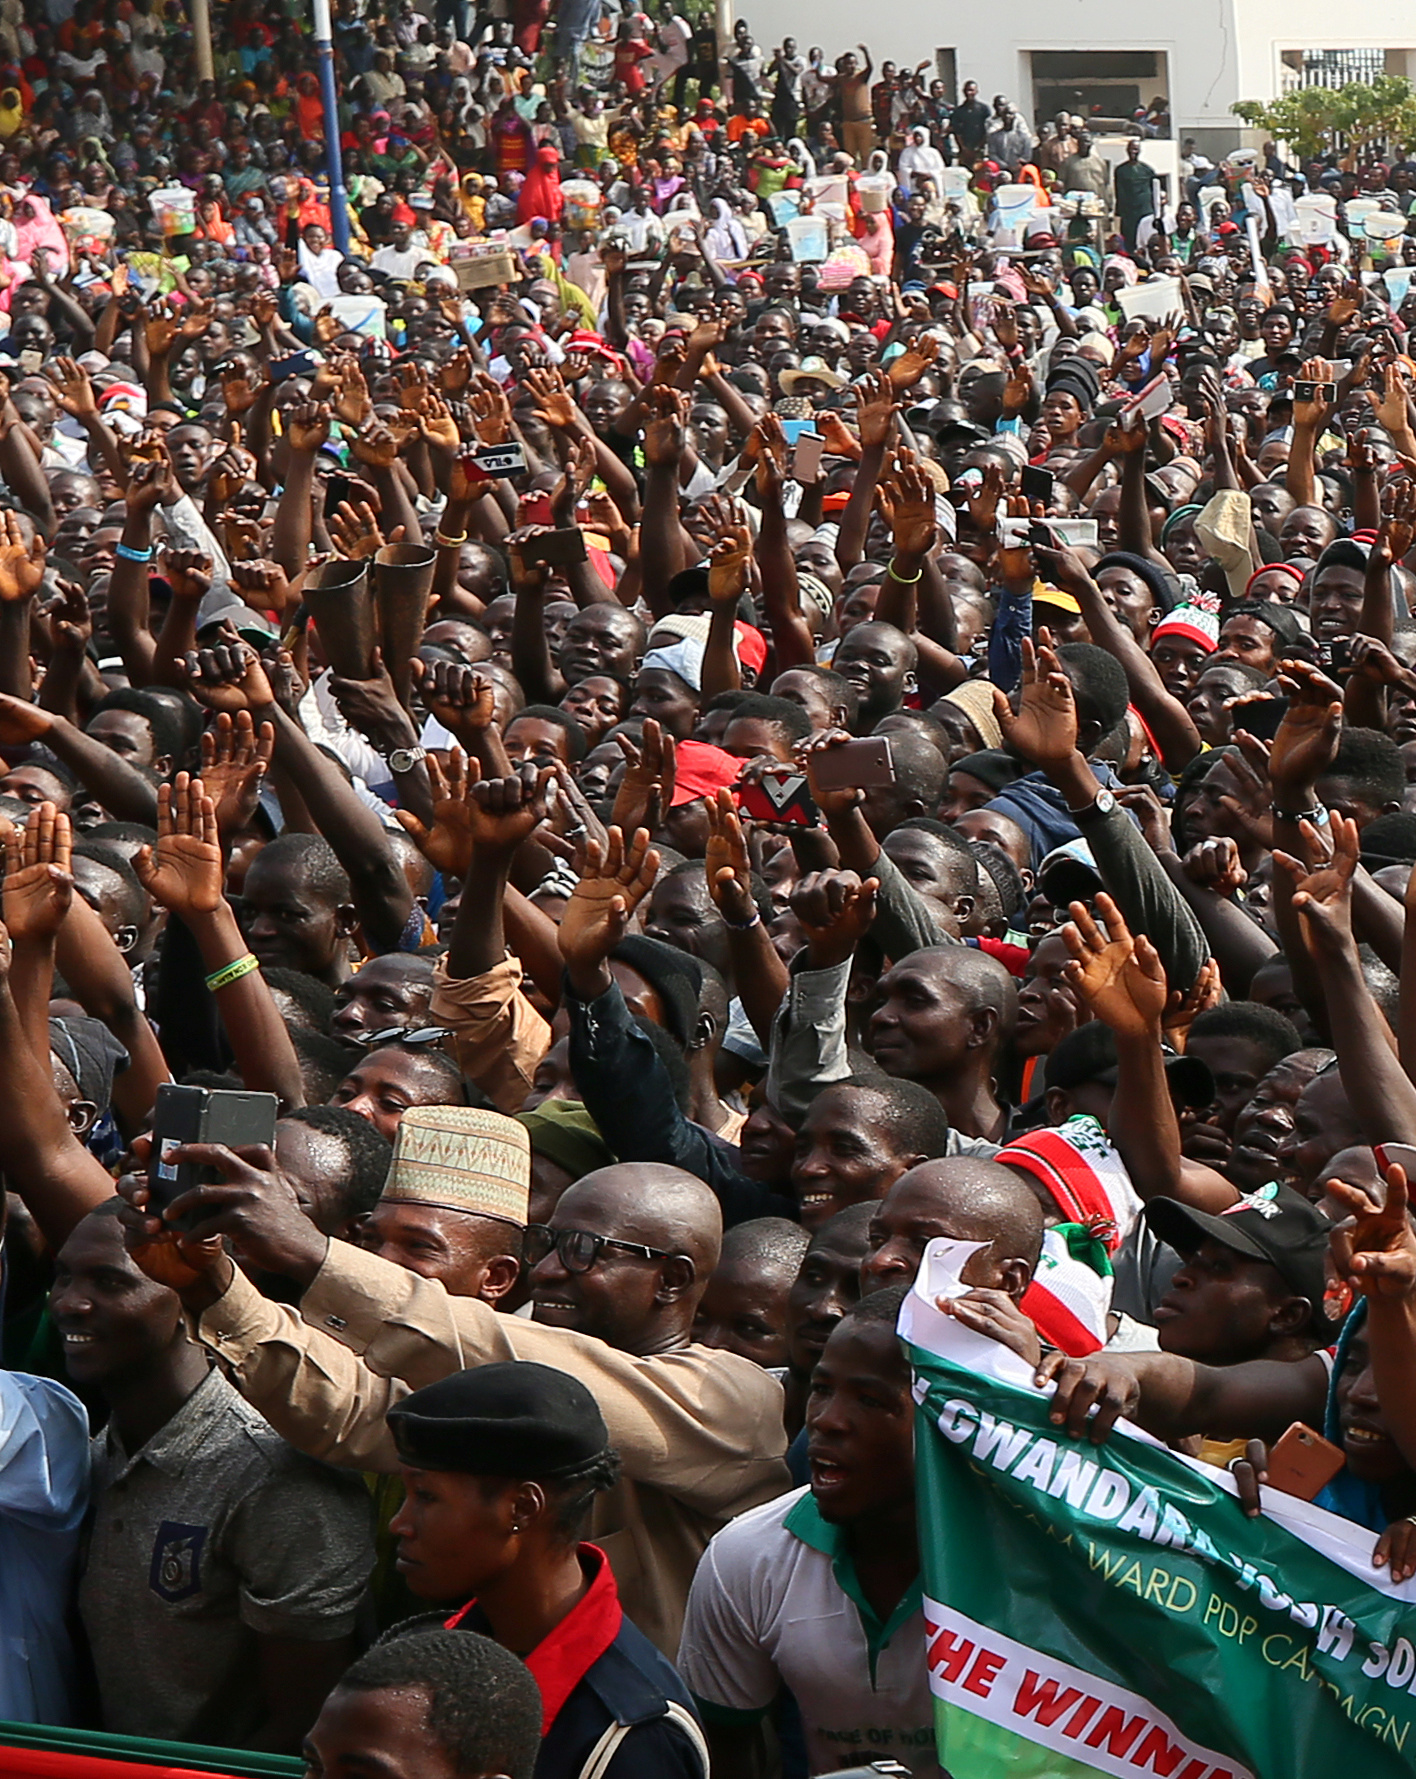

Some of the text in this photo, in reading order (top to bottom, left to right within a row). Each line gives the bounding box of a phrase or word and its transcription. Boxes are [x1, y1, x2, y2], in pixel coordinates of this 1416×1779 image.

[925, 1619, 1008, 1698] HE
[1088, 1542, 1197, 1613] WARD
[1204, 1593, 1258, 1645] PDP
[1262, 1634, 1411, 1752] CAAIGN
